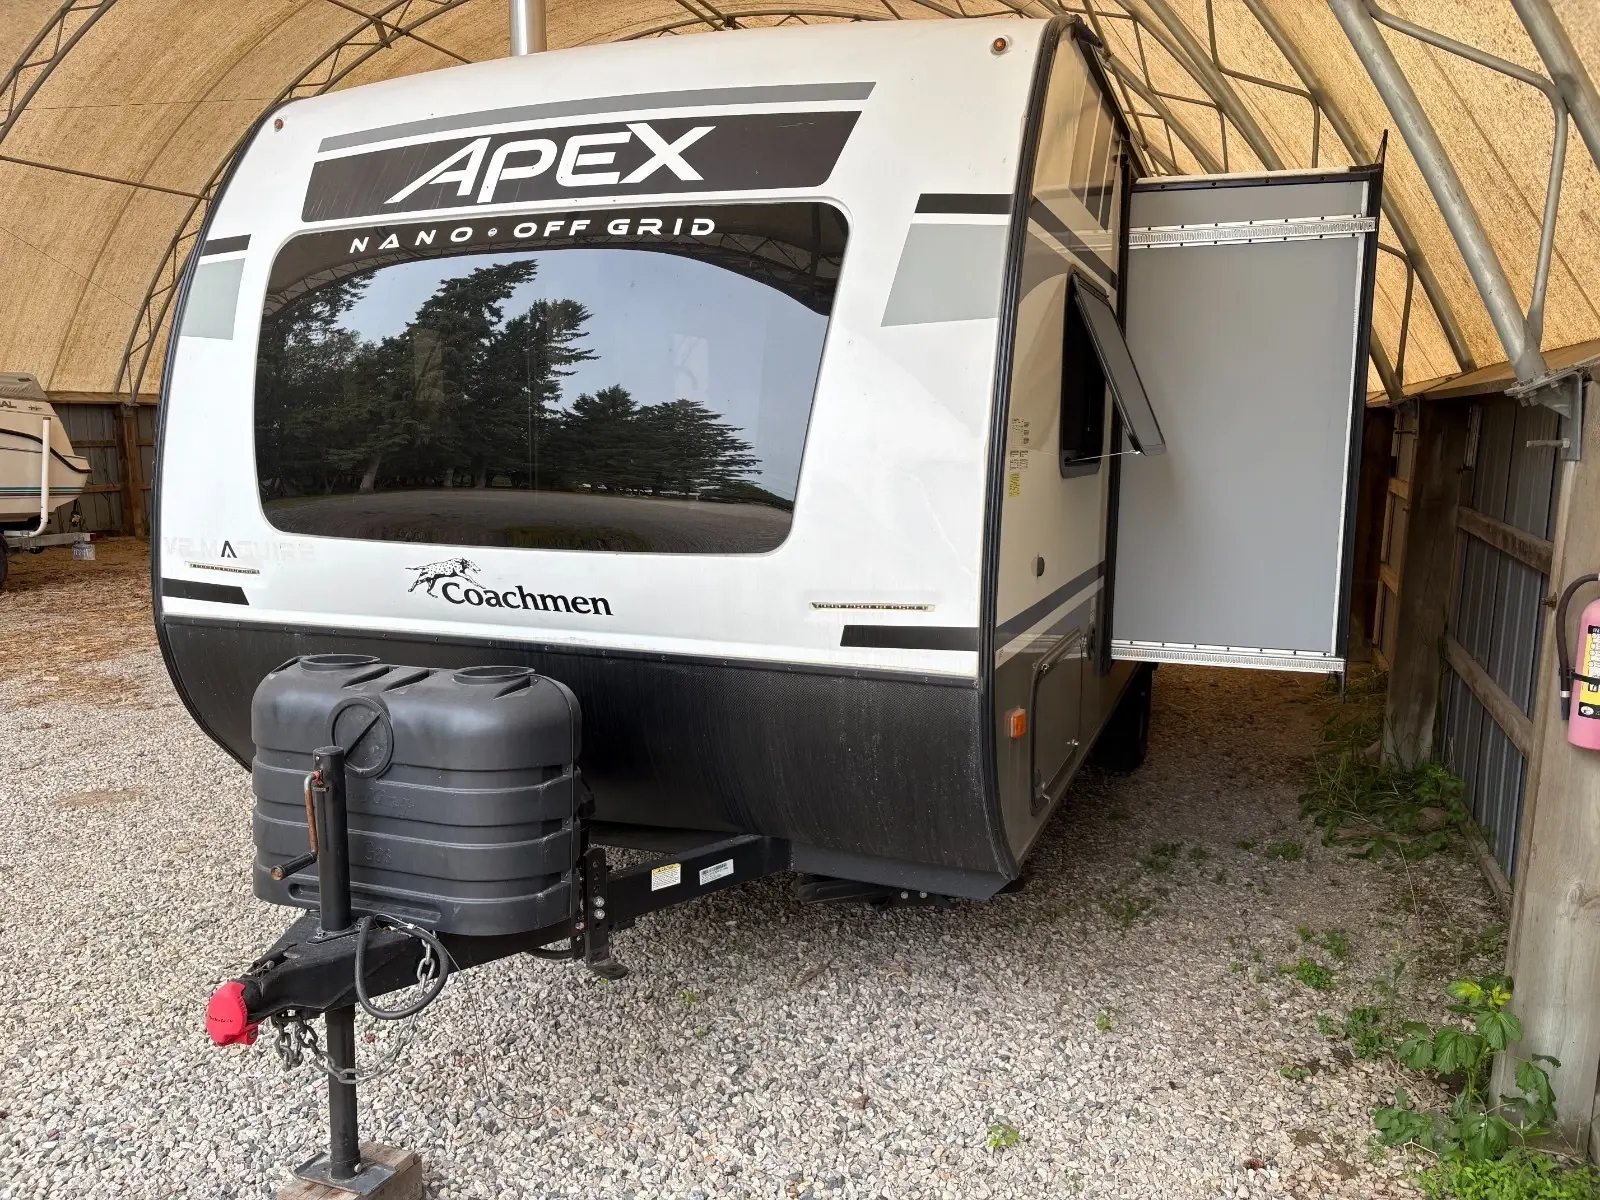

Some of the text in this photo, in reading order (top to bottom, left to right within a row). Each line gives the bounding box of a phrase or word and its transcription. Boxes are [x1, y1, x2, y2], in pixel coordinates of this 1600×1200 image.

[384, 122, 717, 204] APEX
[350, 218, 715, 254] NANO OFF GRID
[0, 400, 17, 408] AL
[441, 582, 614, 616] Coachmen
